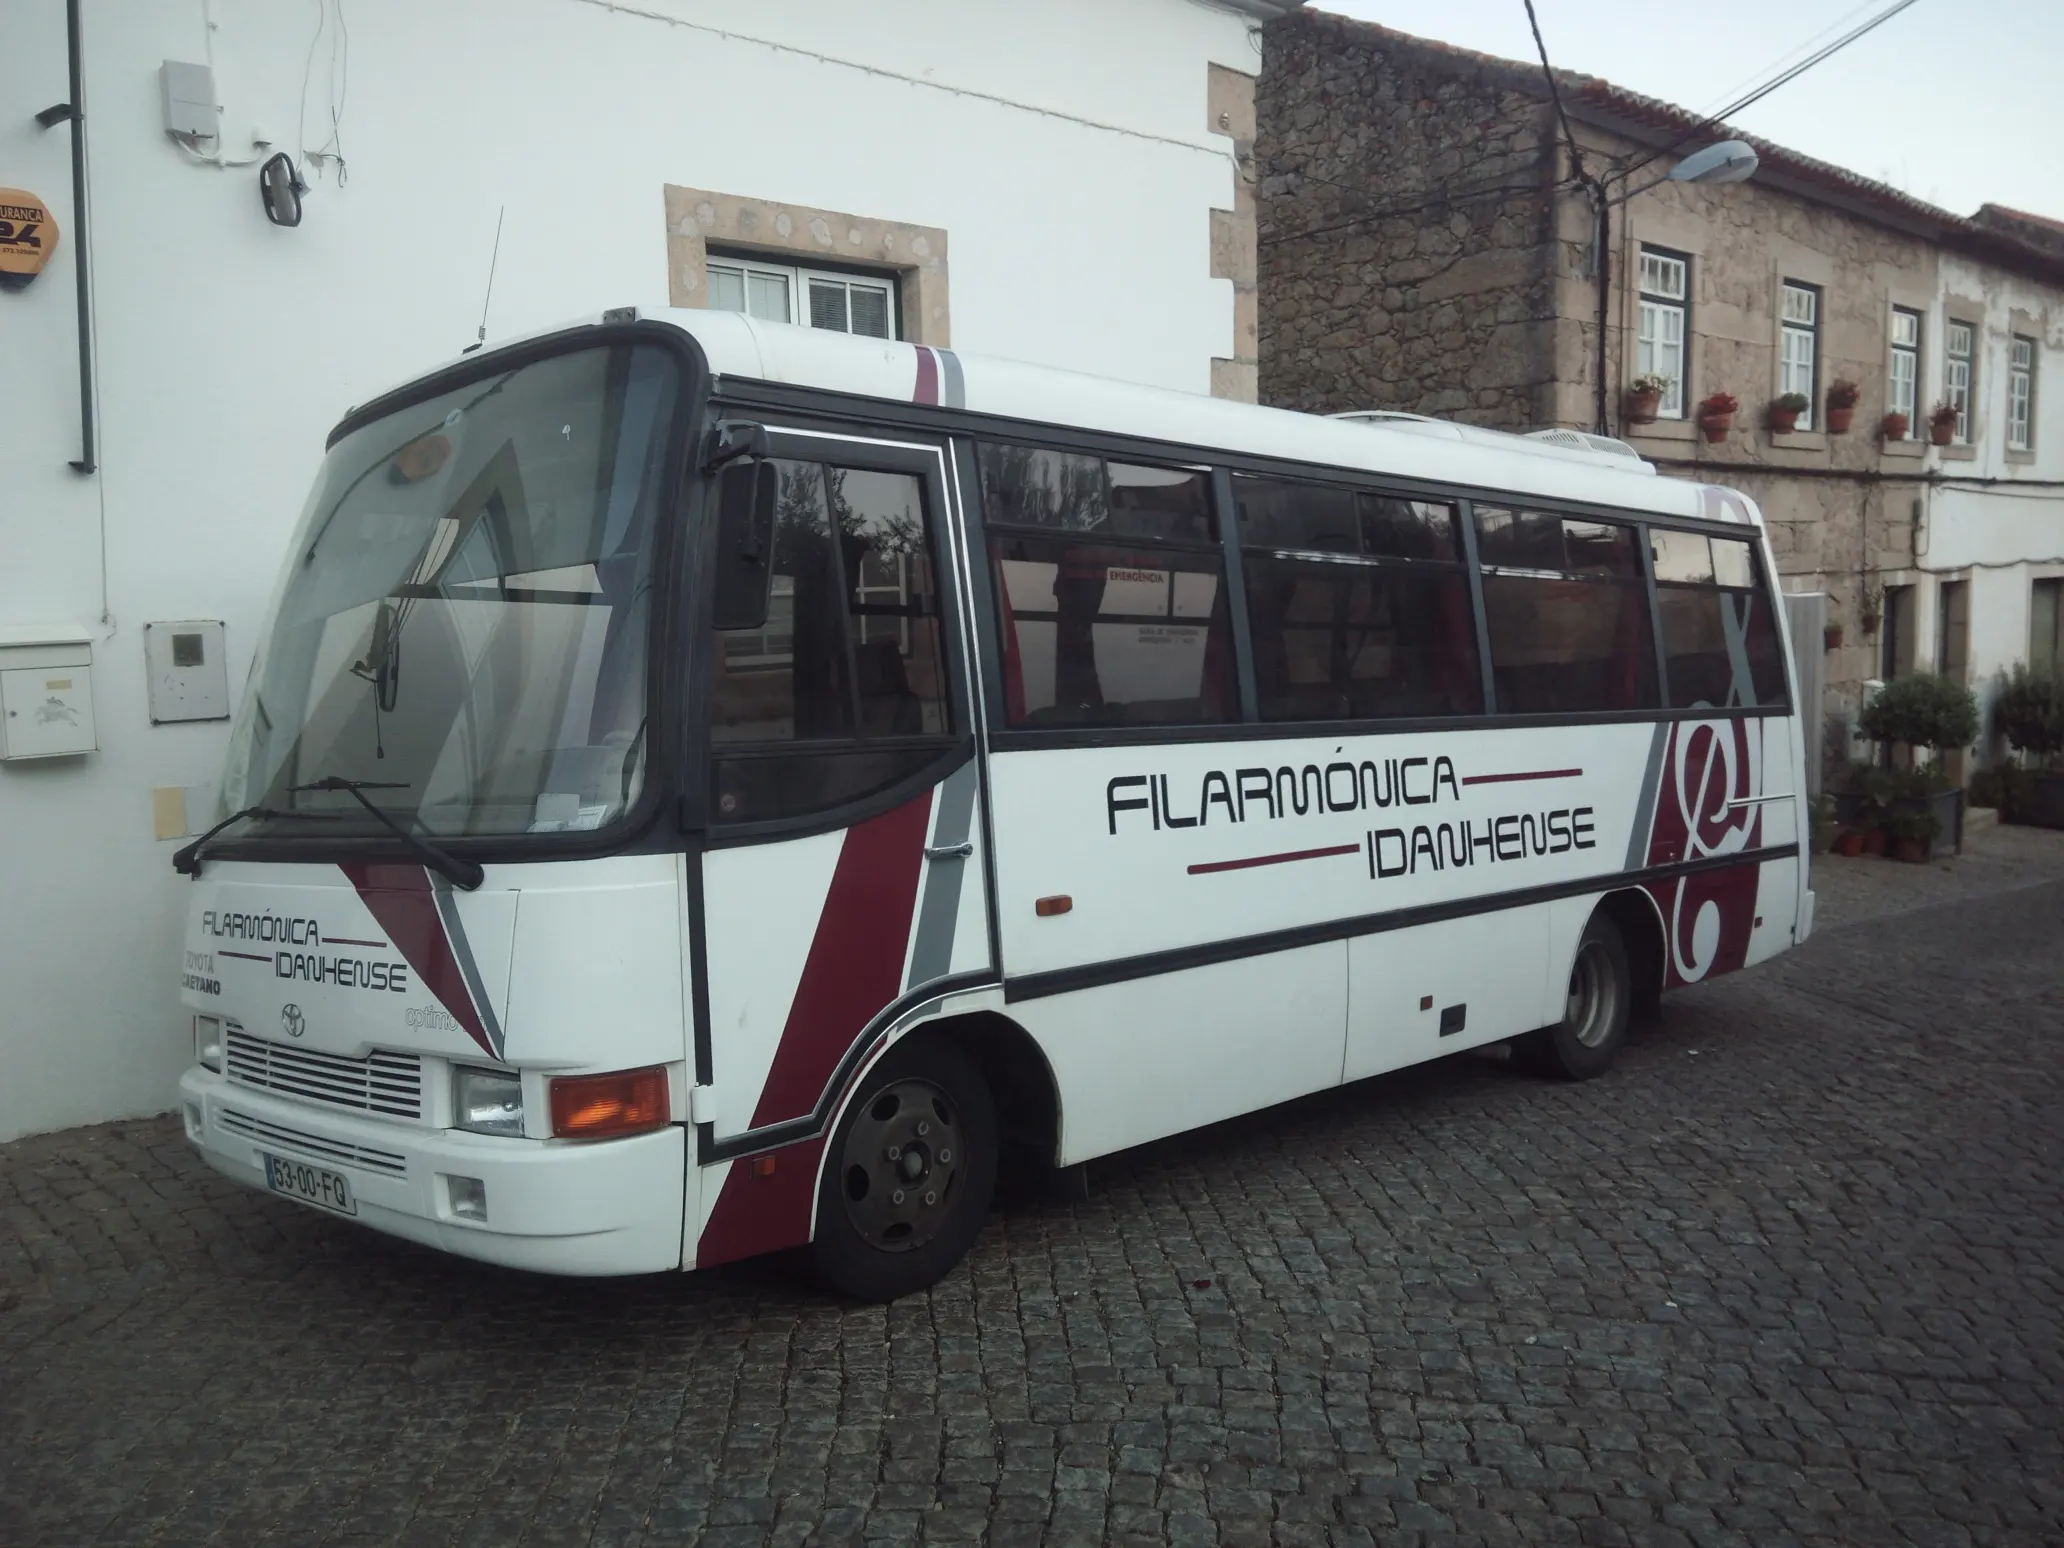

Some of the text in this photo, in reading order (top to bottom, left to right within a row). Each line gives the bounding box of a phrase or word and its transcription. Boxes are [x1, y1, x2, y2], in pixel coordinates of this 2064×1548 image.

[1109, 569, 1164, 583] EMERGÊNCIA
[1106, 746, 1460, 835] FILARMÓNICA
[1367, 806, 1596, 880] IDANHENSE
[202, 908, 319, 947] FILARMÓNICA
[185, 950, 214, 974] TOYOTA
[275, 951, 408, 993] IDANHENSE
[405, 1004, 458, 1033] optimo
[272, 1156, 347, 1208] 53-00-FQ
